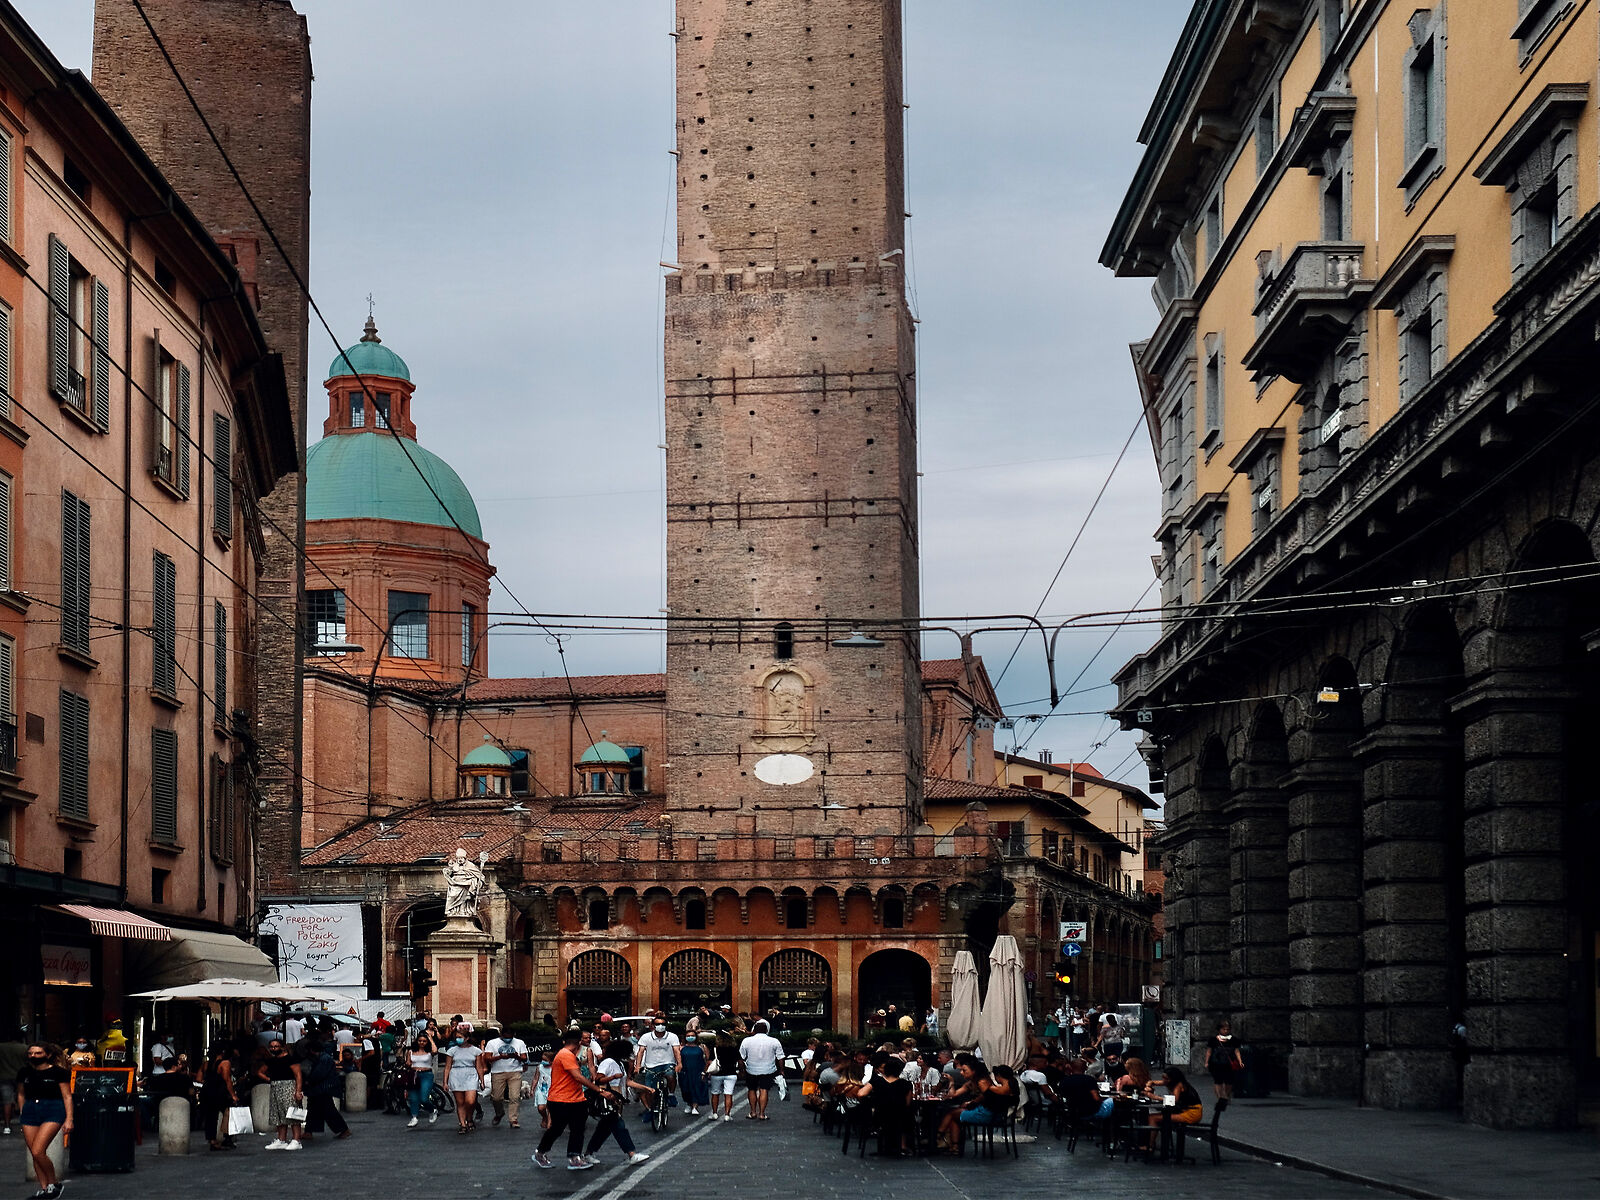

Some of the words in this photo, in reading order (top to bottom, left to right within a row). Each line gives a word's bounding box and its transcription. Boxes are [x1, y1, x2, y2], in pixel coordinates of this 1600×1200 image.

[1138, 713, 1151, 721] 13
[976, 721, 990, 729] 14
[1000, 721, 1013, 729] 15
[308, 941, 338, 953] Zaky
